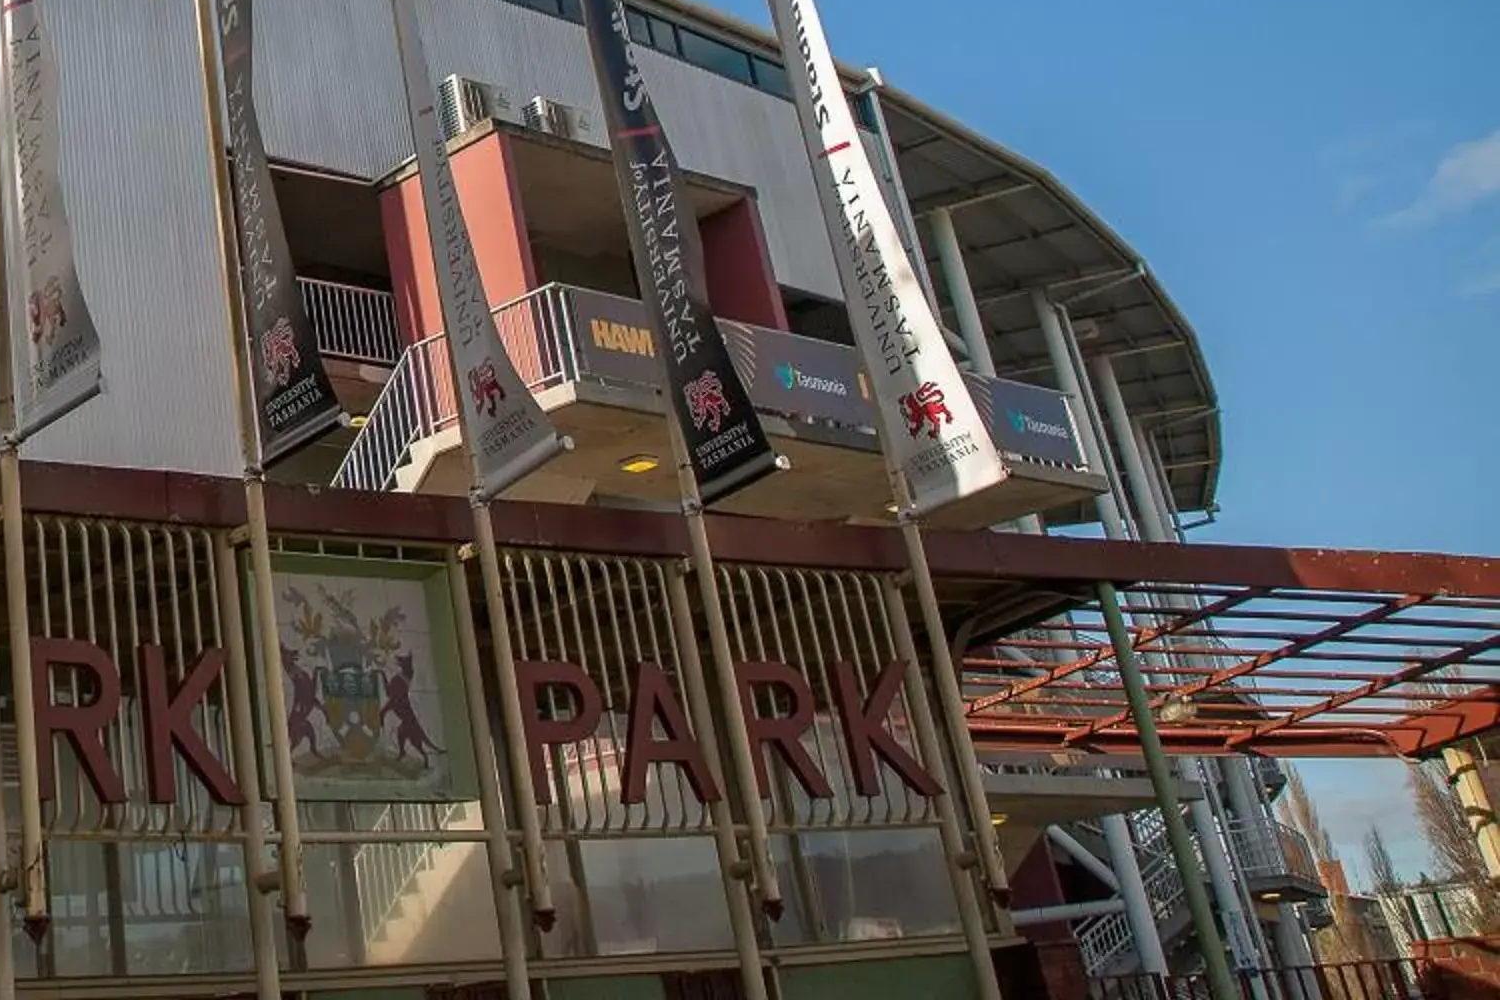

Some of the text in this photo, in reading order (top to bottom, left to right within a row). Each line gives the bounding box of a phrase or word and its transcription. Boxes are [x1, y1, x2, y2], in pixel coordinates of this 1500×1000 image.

[435, 160, 474, 347] UNIVERSITY
[633, 183, 687, 365] UNIVERSITY
[651, 147, 702, 354] TASMANIA
[841, 167, 922, 365] TASMANIA
[700, 433, 756, 471] TASMANIA
[794, 369, 848, 397] Tasmania
[513, 660, 946, 804] PARK
